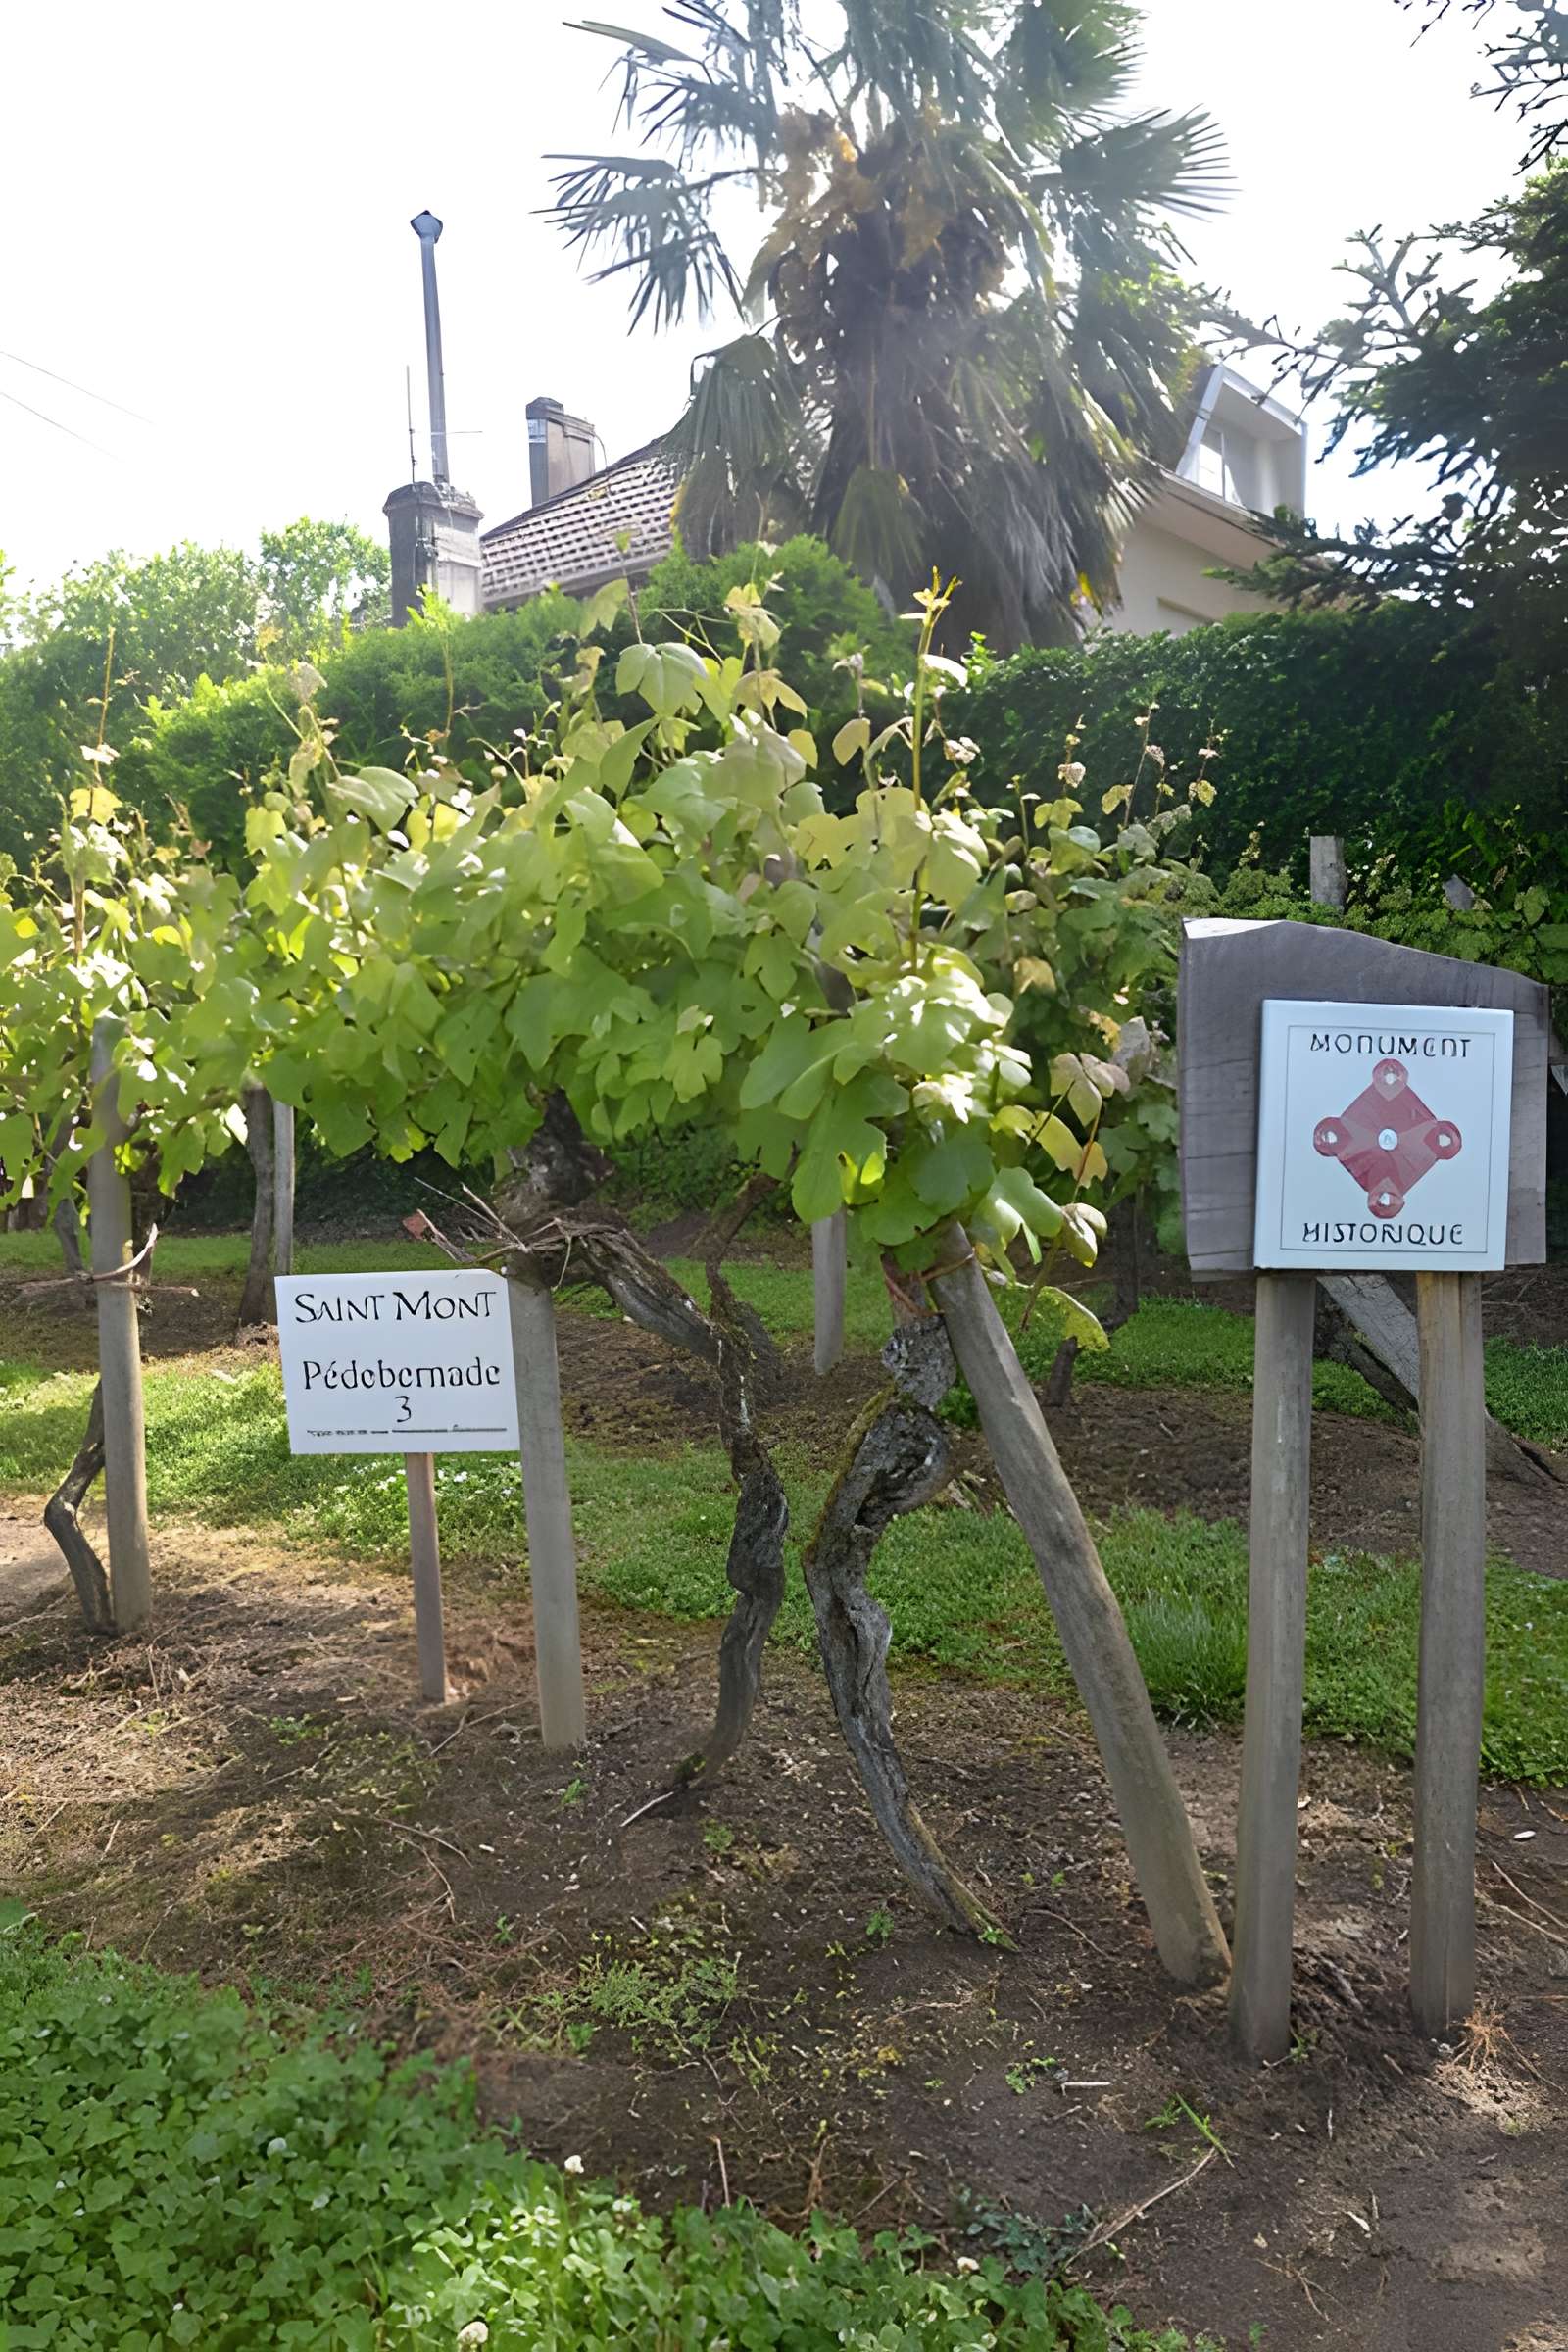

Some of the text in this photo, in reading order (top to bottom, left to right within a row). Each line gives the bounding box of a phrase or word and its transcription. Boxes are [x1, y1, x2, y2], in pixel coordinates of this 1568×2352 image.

[1309, 1033, 1472, 1058] MONUMENT
[1301, 1222, 1464, 1247] HISTORIQUE
[294, 1290, 497, 1324] SAINT MONT
[394, 1395, 412, 1424] 3
